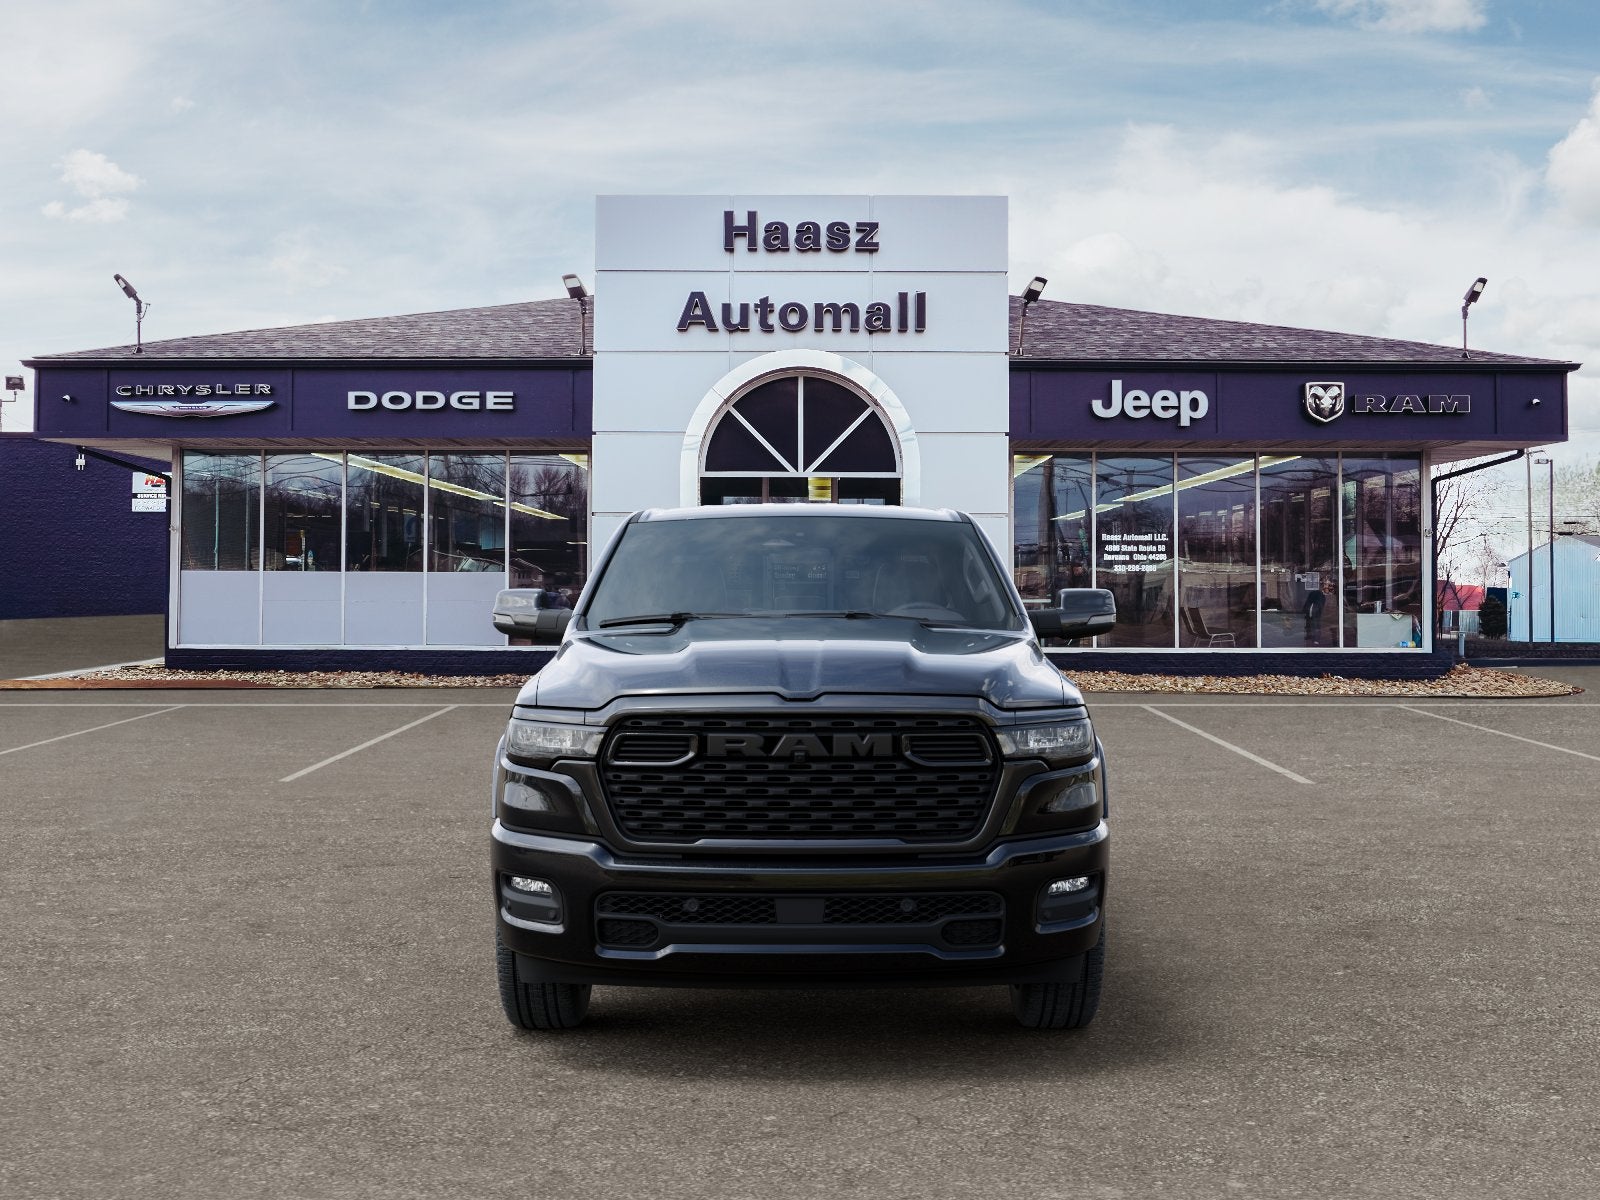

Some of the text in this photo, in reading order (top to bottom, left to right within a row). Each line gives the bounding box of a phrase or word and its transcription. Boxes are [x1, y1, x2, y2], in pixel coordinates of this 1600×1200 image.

[723, 210, 880, 252] Haasz
[676, 291, 927, 333] Automall
[115, 383, 272, 396] CHRYSLER
[347, 391, 514, 410] DODGE
[1091, 379, 1209, 427] Jeep
[1354, 394, 1471, 413] RAM
[1122, 533, 1153, 541] Automall
[1120, 544, 1138, 552] State
[1138, 544, 1157, 552] Route
[706, 733, 893, 757] RAM
